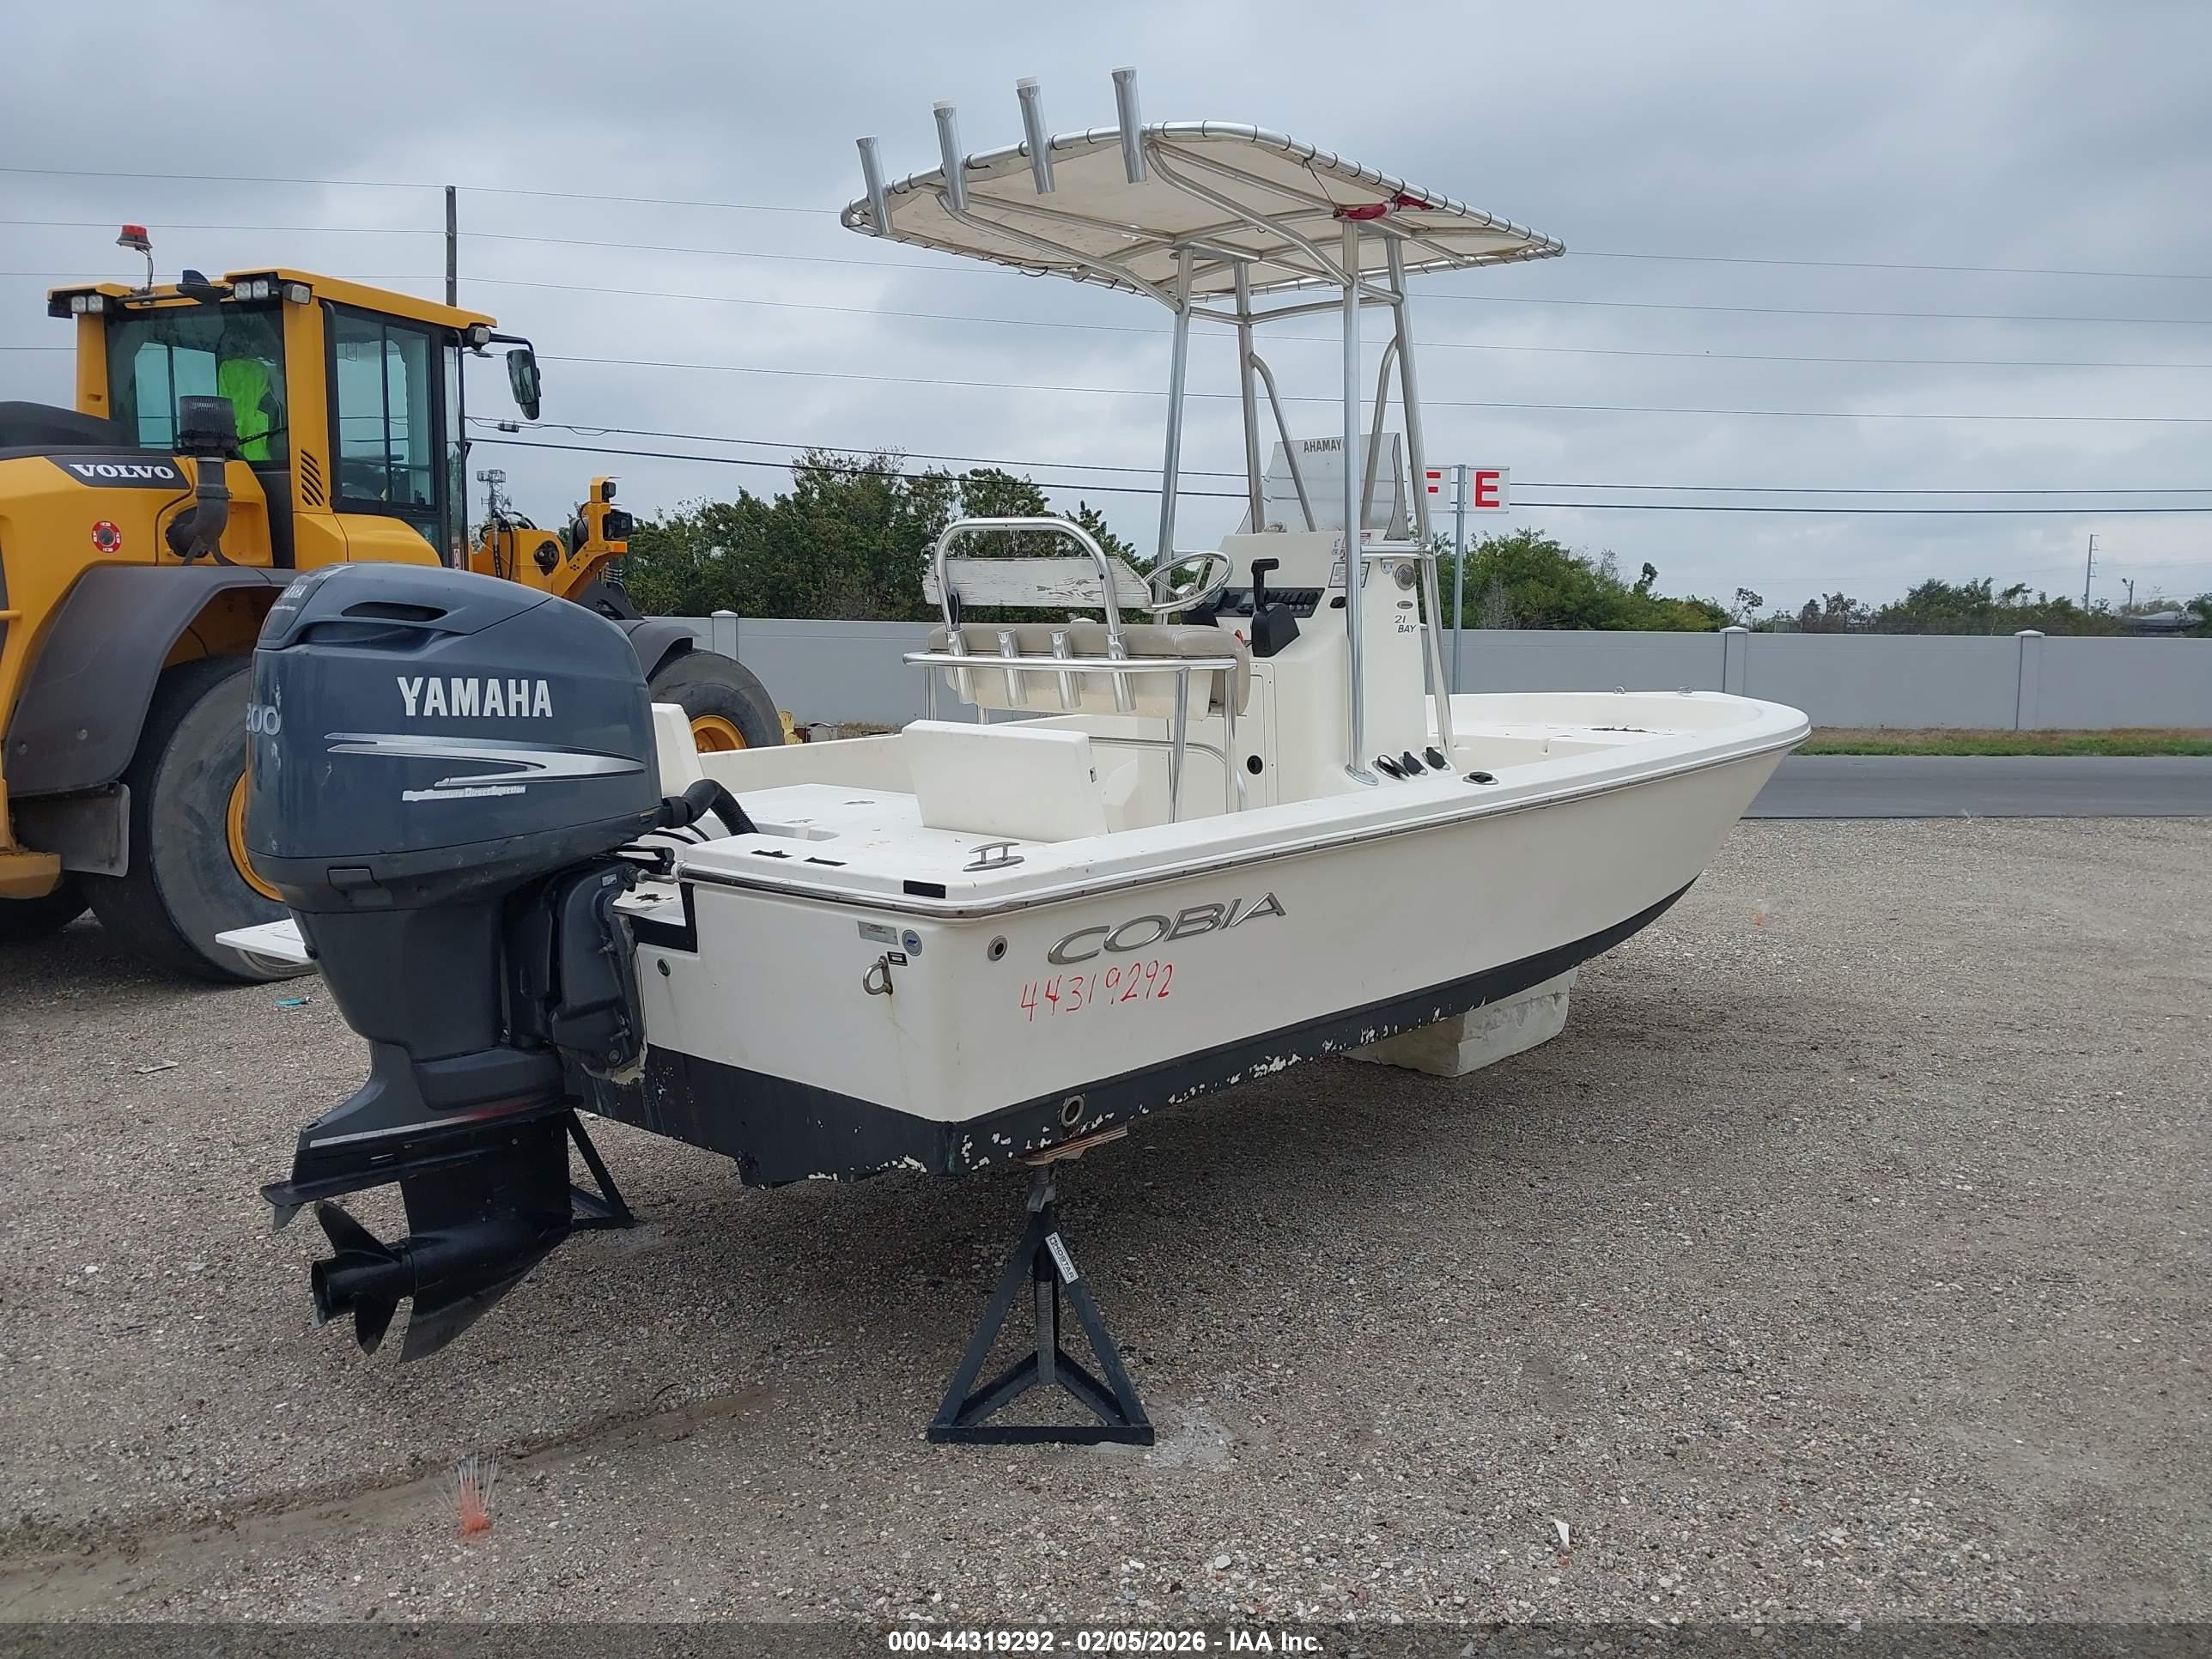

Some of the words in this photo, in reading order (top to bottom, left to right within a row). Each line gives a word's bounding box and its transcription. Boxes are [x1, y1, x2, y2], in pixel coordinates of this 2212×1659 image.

[69, 464, 174, 479] VOLVO
[1475, 471, 1500, 507] E
[1395, 615, 1407, 624] 21
[1397, 624, 1417, 634] BAY
[397, 676, 553, 718] YAMAHA
[1048, 891, 1286, 965] COBIA
[1020, 959, 1173, 1022] 44319292
